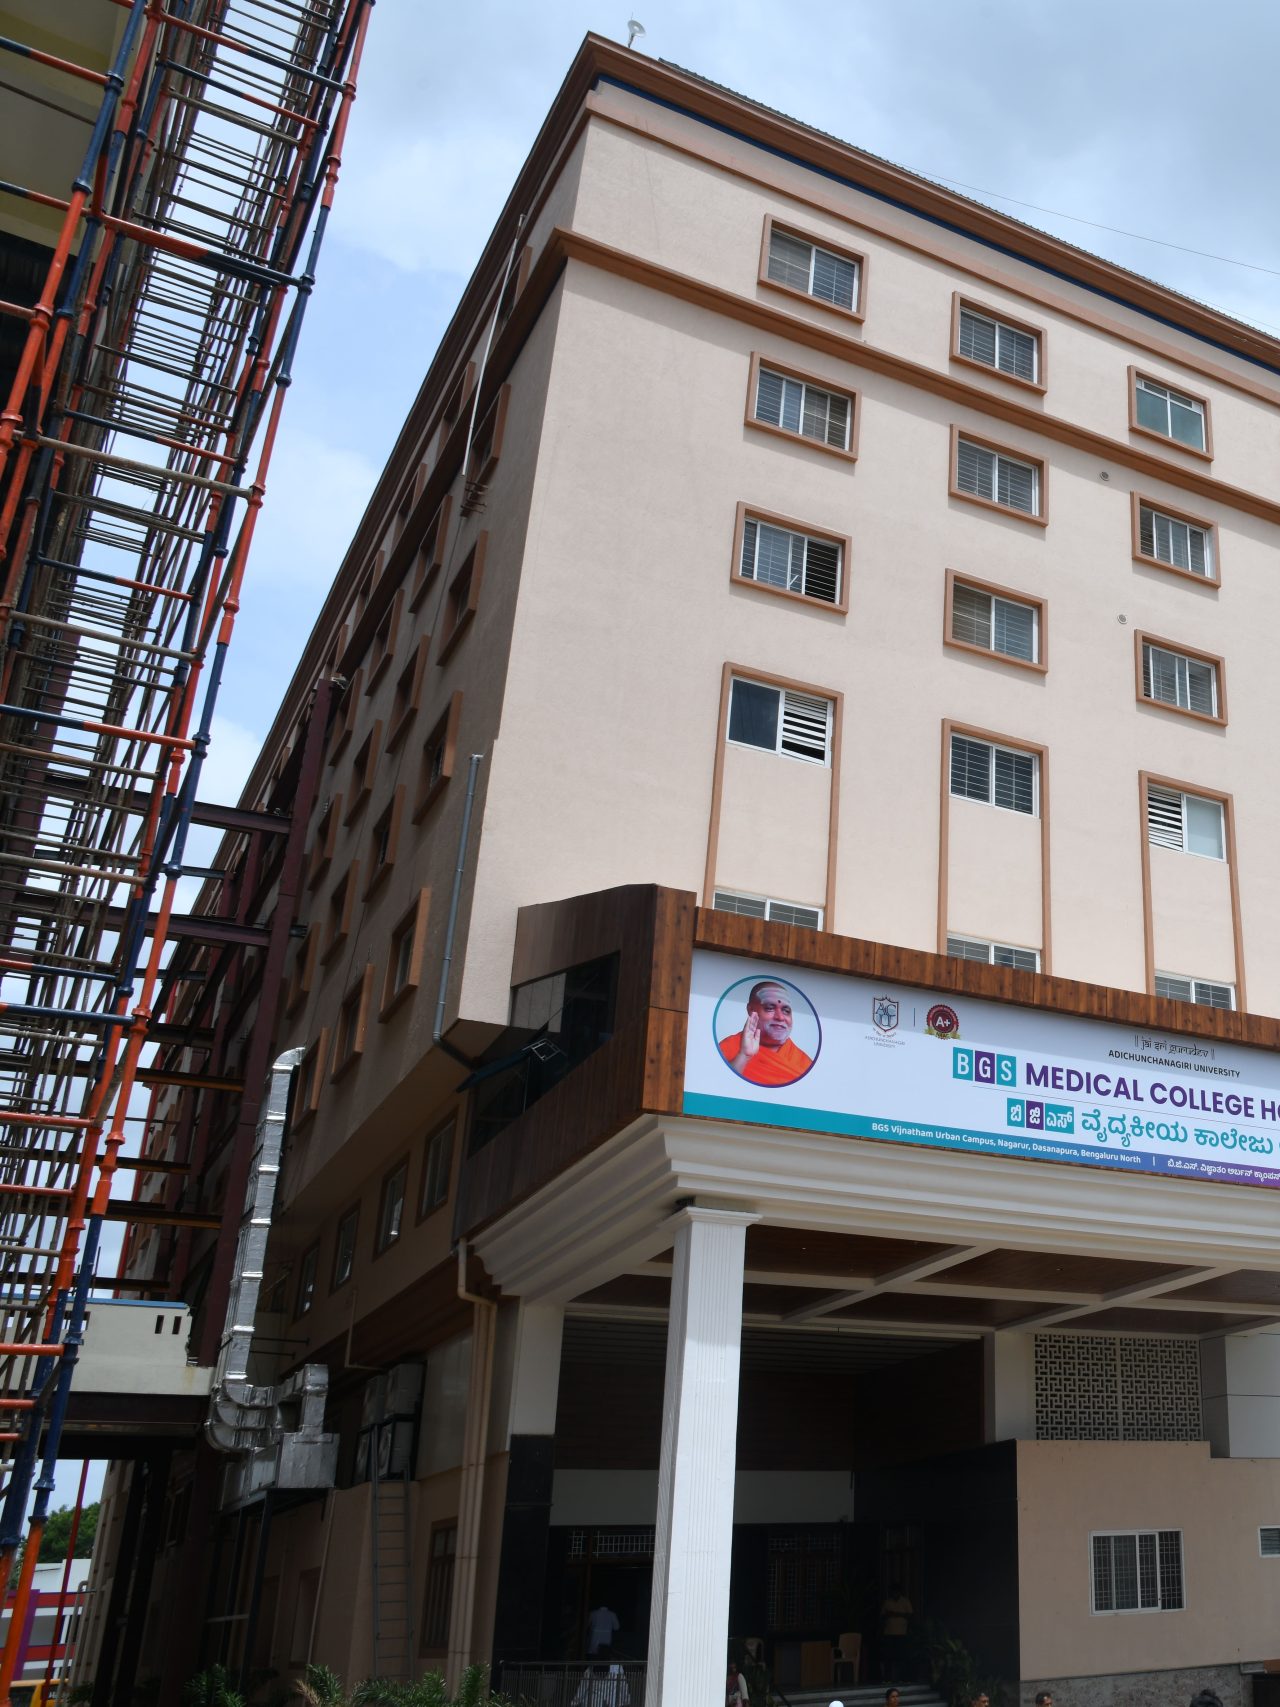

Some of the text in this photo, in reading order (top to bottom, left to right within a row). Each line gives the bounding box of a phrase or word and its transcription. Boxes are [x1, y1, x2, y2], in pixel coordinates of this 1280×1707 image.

[935, 1016, 951, 1028] A+
[955, 1051, 1014, 1084] BGS
[1025, 1062, 1145, 1102] MEDICAL
[1149, 1082, 1256, 1118] COLLEGE
[1108, 1049, 1241, 1078] ADICHUNCHANAGIRI UNIVERSITY
[871, 1122, 1141, 1164] BGS Vijnatham Urban Campus, Nagarur, Dasanapura, Bengaluru North
[1081, 1108, 1188, 1148] ವೈದ್ಯಕೀಯ
[1193, 1127, 1274, 1155] ಕಾಲೇಜು
